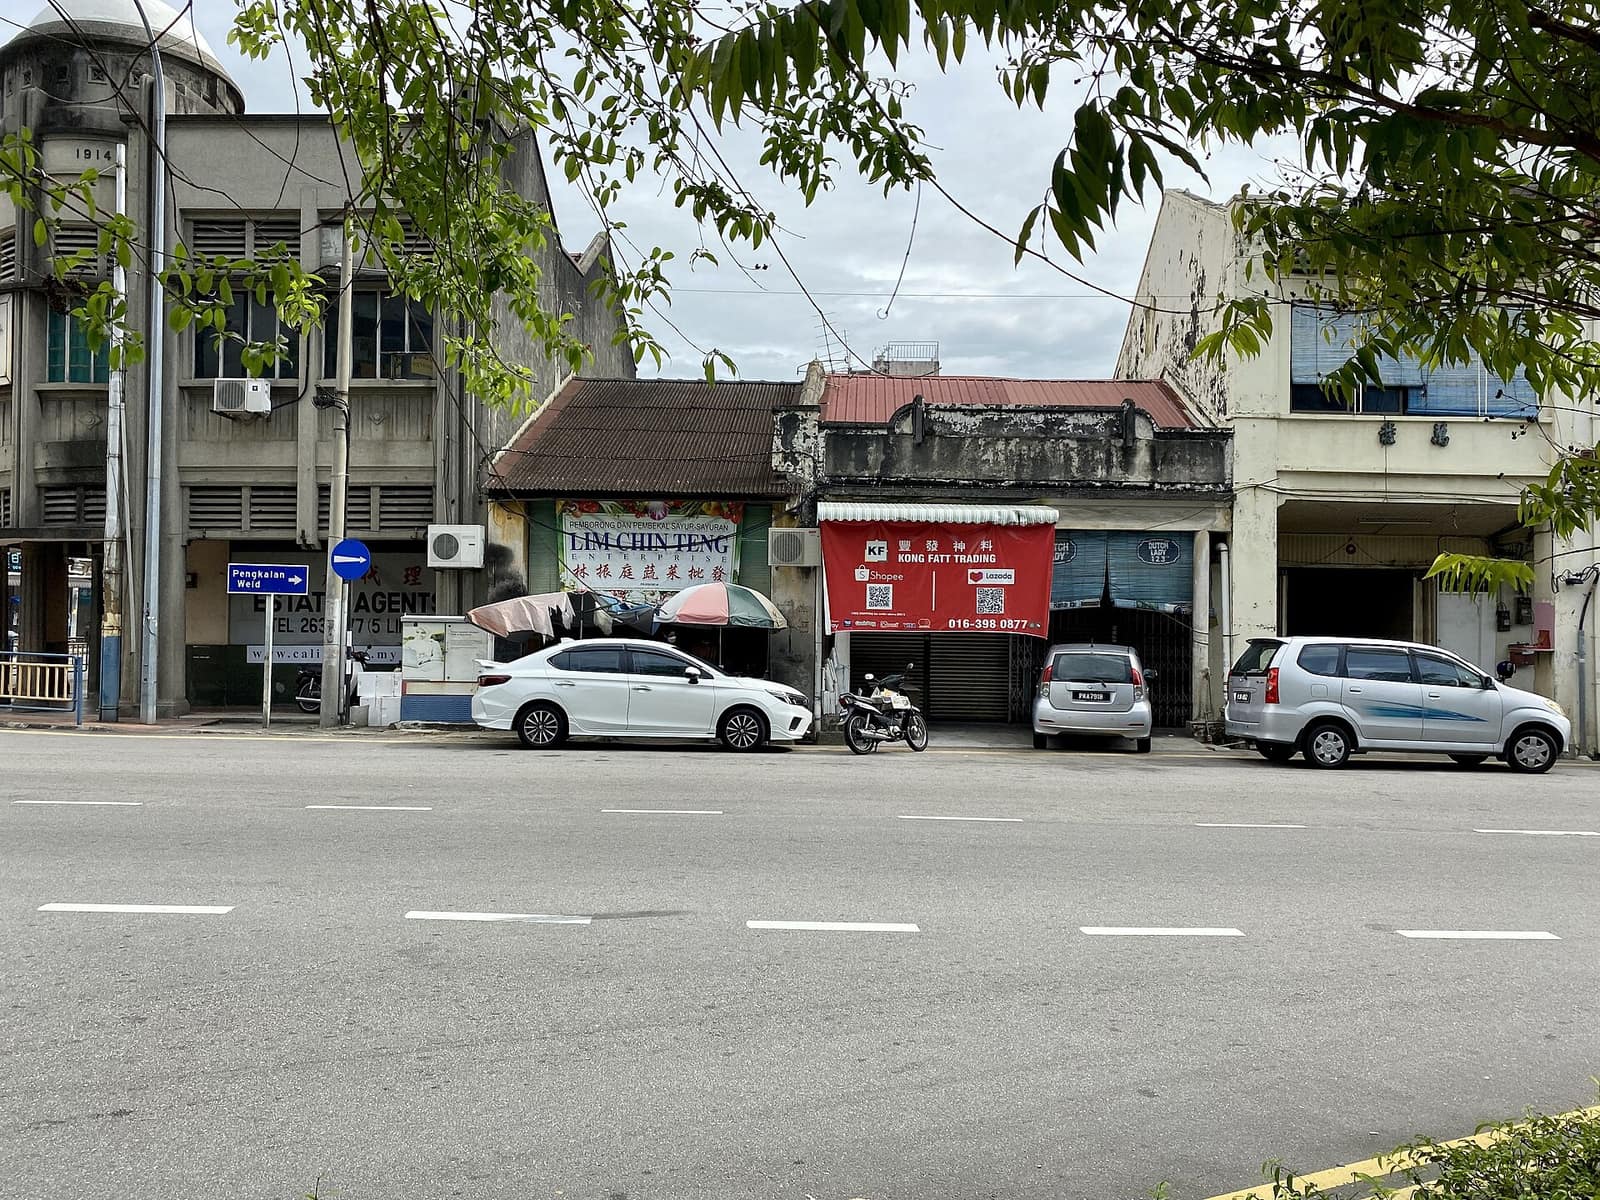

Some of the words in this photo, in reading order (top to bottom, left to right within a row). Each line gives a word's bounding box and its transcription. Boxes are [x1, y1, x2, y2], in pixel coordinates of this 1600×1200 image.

[76, 148, 112, 160] 1914
[570, 521, 615, 529] PEMBORONG
[617, 521, 632, 529] DAN
[633, 521, 670, 530] PEMBEKAL
[672, 522, 729, 531] SAYUR-SAYURAN
[571, 532, 609, 551] LIM
[617, 532, 668, 552] CHIN
[672, 533, 729, 554] TENG
[1053, 543, 1068, 551] TCH
[1149, 542, 1169, 550] DUTCH
[868, 546, 885, 555] KF
[571, 553, 727, 563] ENTERPRISE
[898, 554, 925, 563] KONG
[928, 554, 951, 563] FATT
[953, 554, 996, 563] TRADING
[1053, 552, 1065, 560] DY
[233, 570, 285, 581] Pengkalan
[573, 563, 727, 581] 林振庭蔬菜批發
[870, 571, 903, 582] Shopee
[986, 572, 1012, 580] Lazada
[237, 580, 261, 588] Weld
[253, 592, 326, 613] ESTAT
[273, 618, 294, 633] TEL
[367, 618, 380, 633] (5
[948, 619, 996, 629] 016-398
[1000, 619, 1028, 629] 0877
